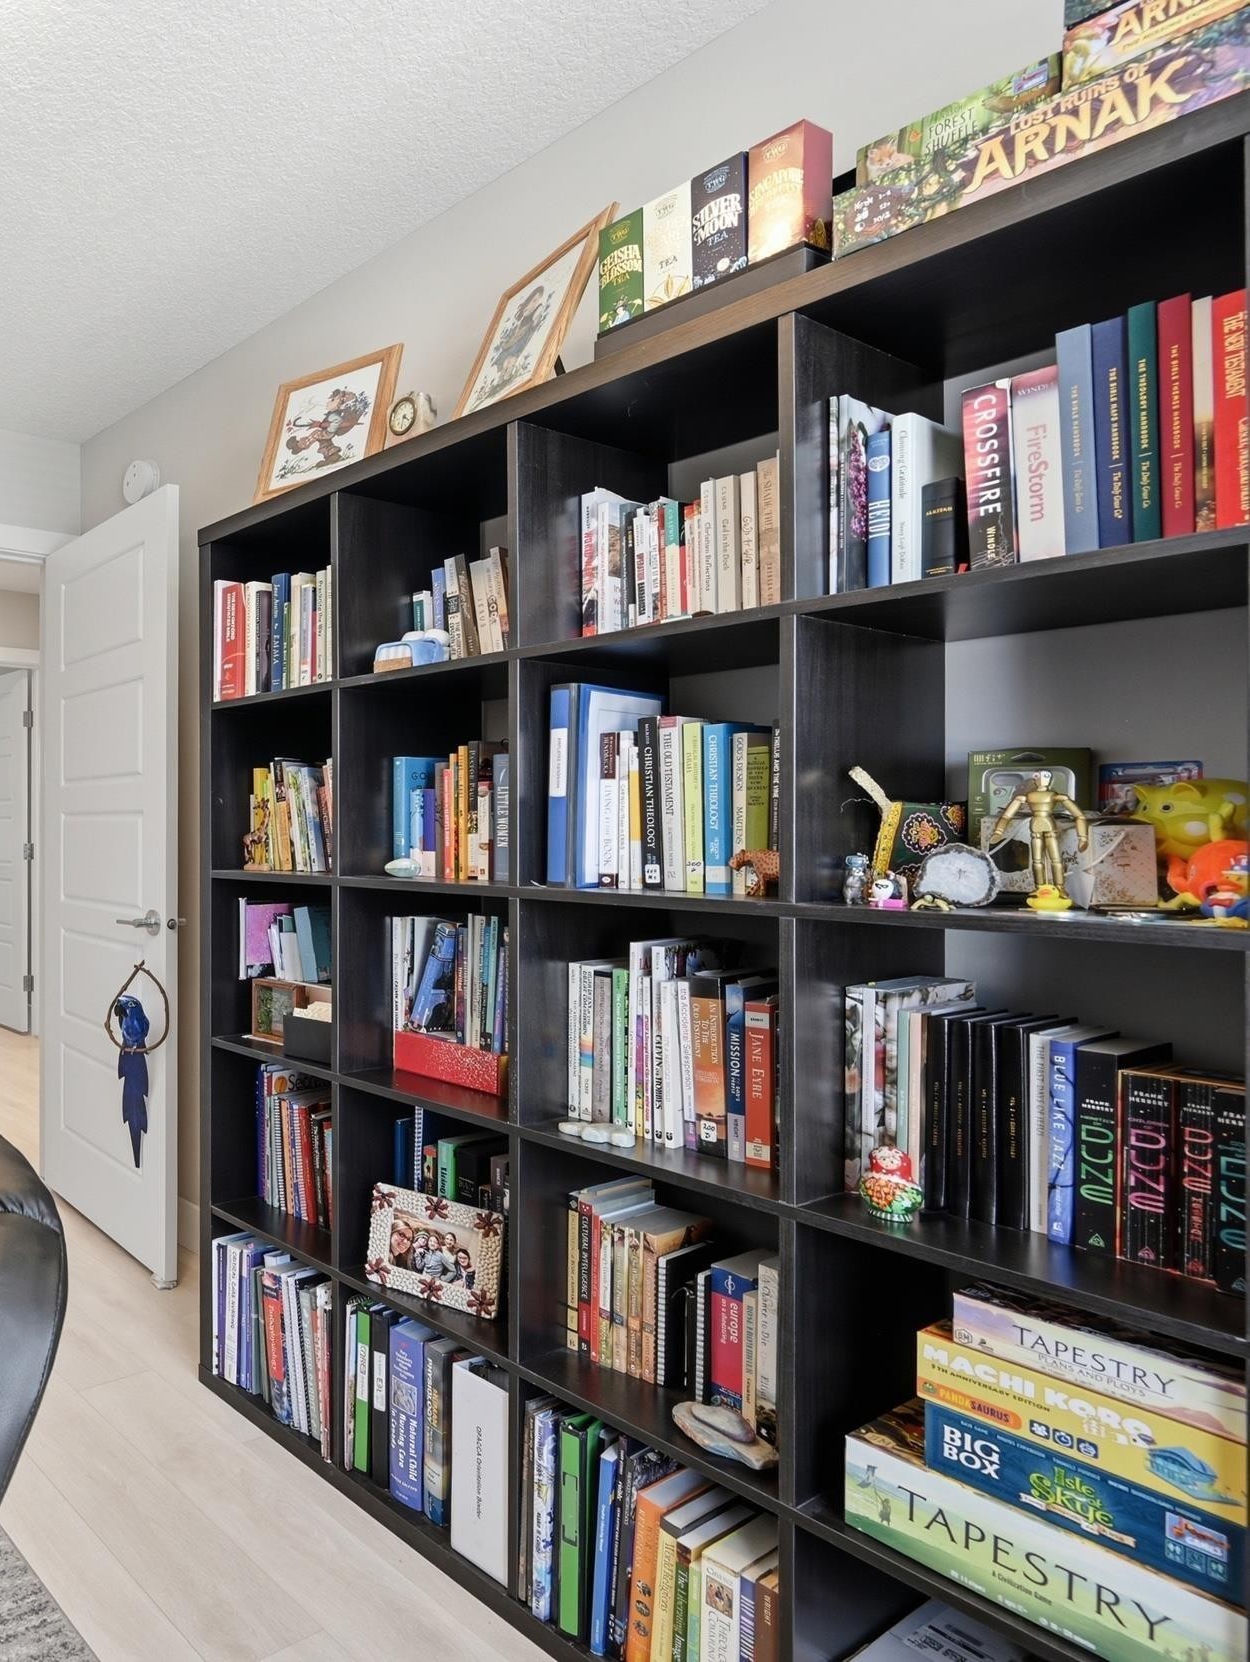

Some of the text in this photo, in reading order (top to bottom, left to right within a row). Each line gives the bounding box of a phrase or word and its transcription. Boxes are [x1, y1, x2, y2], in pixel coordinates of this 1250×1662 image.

[1011, 63, 1149, 135] LOST RUINS OF
[925, 121, 978, 154] SHUFFLE
[928, 107, 975, 138] FOREST
[961, 56, 1193, 194] ARNAK
[693, 193, 742, 231] SILVER
[694, 212, 740, 246] MOON
[600, 245, 640, 276] GEISHA
[707, 232, 729, 247] TEA
[600, 259, 642, 290] BLOSSOM
[613, 272, 630, 287] TEA
[658, 255, 678, 270] TEA
[1223, 312, 1244, 333] THE
[1224, 331, 1245, 353] NEW
[1170, 345, 1182, 449] THE BIBLE THEMES HANDBOOK
[1225, 351, 1247, 399] TESTAMENT
[1071, 385, 1082, 457] THE BIBLE HANDBOOK
[1108, 367, 1120, 460] THE BIBLE MAPS HANDBOOK
[1137, 359, 1149, 449] THE THEOLOGY HANDBOOK
[971, 393, 1003, 518] CROSSFIRE
[1026, 424, 1049, 523] FireStorm
[868, 500, 890, 539] HEIDI
[703, 522, 713, 592] Christian Reflections
[986, 526, 997, 560] WINDLE
[636, 553, 645, 582] OPERATION
[477, 597, 487, 628] JESUS
[662, 732, 672, 750] THE
[663, 751, 673, 768] OLD
[708, 735, 718, 781] CHRISTIAN
[643, 747, 655, 799] CHRISTIAN
[735, 737, 744, 792] GOD'S DESIGN
[664, 768, 674, 817] TESTAMENT
[708, 783, 718, 830] THEOLOGY
[497, 786, 509, 848] LITTLE WOMEN
[603, 785, 614, 867] LIVING BOOK
[646, 799, 656, 849] THEOLOGY
[736, 807, 744, 845] MARTENS
[681, 1002, 690, 1041] Accidental
[693, 1003, 702, 1059] OLD TESTAMENT
[701, 1020, 710, 1044] TO THE
[709, 1001, 719, 1065] AN INTRODUCTION
[654, 1034, 663, 1110] CALVIN HOBBES
[684, 1044, 692, 1091] Salesperson
[729, 1032, 741, 1078] MISSION
[749, 1031, 765, 1100] JANE EYRE
[1036, 1046, 1045, 1137] THE FIRST DAYS JESUS
[1052, 1055, 1067, 1171] BLUE LIKE JAZZ
[1081, 1103, 1115, 1113] HERBERT
[1085, 1098, 1110, 1107] FRANK
[1128, 1096, 1170, 1108] HERBERT
[1133, 1090, 1164, 1100] FRANK
[1182, 1107, 1215, 1116] HERBERT
[1186, 1102, 1211, 1111] FRANK
[1080, 1123, 1114, 1206] DUNE
[1128, 1128, 1166, 1215] DUNE
[581, 1215, 591, 1300] CULTURAL INTELLIGENCE
[267, 1304, 277, 1371] Pathophysiology
[720, 1312, 728, 1344] shoestring
[728, 1302, 740, 1344] europe
[745, 1304, 753, 1326] ROSE
[760, 1286, 771, 1348] Chance Die
[1013, 1324, 1175, 1394] TAPESTRY
[1038, 1353, 1146, 1398] PLANS AND PLOYS
[923, 1343, 1155, 1450] MACHI KORO
[950, 1370, 1010, 1397] ANNIVERSARY
[1012, 1394, 1051, 1413] EDITION
[390, 1418, 398, 1449] Canada
[398, 1413, 407, 1469] Nursing Care
[408, 1418, 419, 1481] Maternal Child
[943, 1424, 1000, 1465] BIG
[943, 1442, 999, 1480] BOX
[1053, 1465, 1095, 1498] Isle
[1029, 1472, 1115, 1528] Skye
[634, 1508, 647, 1569] RELIGIONS
[662, 1542, 676, 1568] World
[897, 1484, 1172, 1642] TAPESTRY
[658, 1569, 673, 1614] Religions
[764, 1594, 772, 1626] WRIGHT
[997, 1573, 1053, 1606] Civilization Game
[671, 1570, 688, 1662] The Liberating Image
